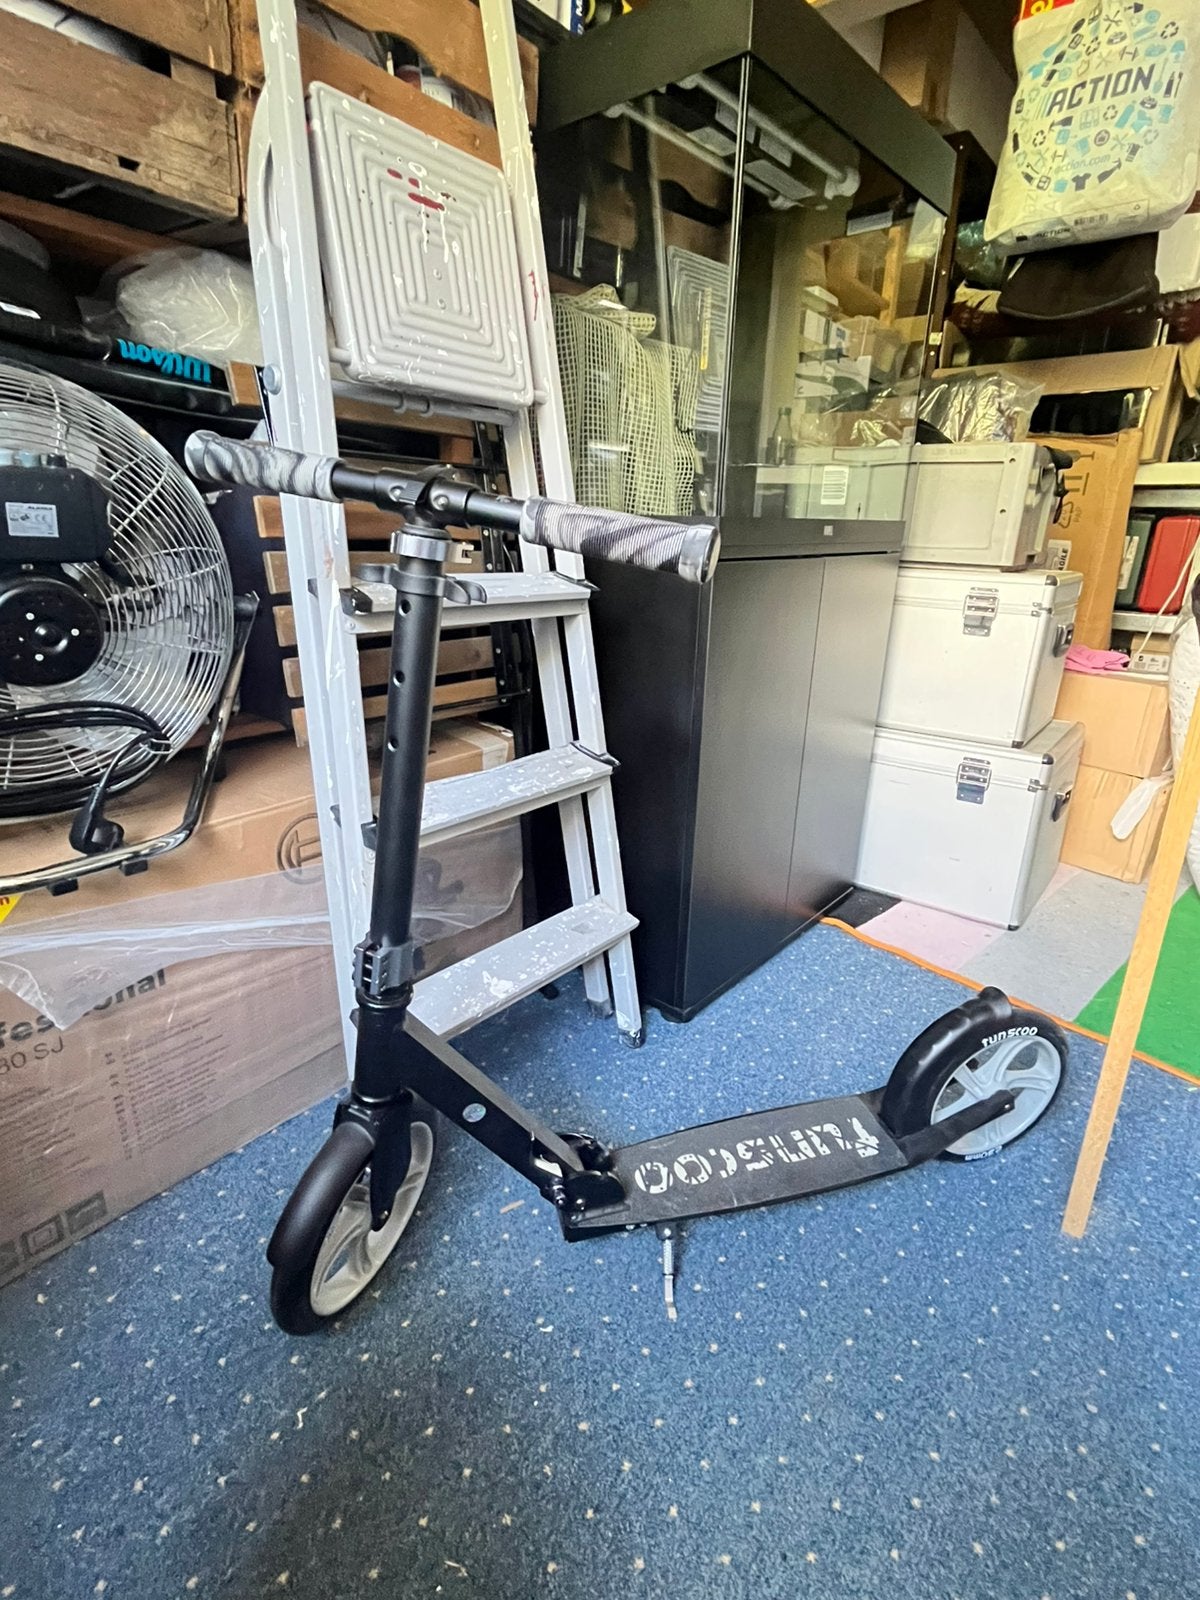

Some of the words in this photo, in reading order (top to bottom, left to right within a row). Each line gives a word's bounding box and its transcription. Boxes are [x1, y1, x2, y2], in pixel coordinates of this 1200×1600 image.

[1047, 64, 1156, 117] ACTION
[118, 340, 211, 383] Wilson
[34, 1036, 63, 1060] SJ
[634, 1116, 880, 1194] funscoo
